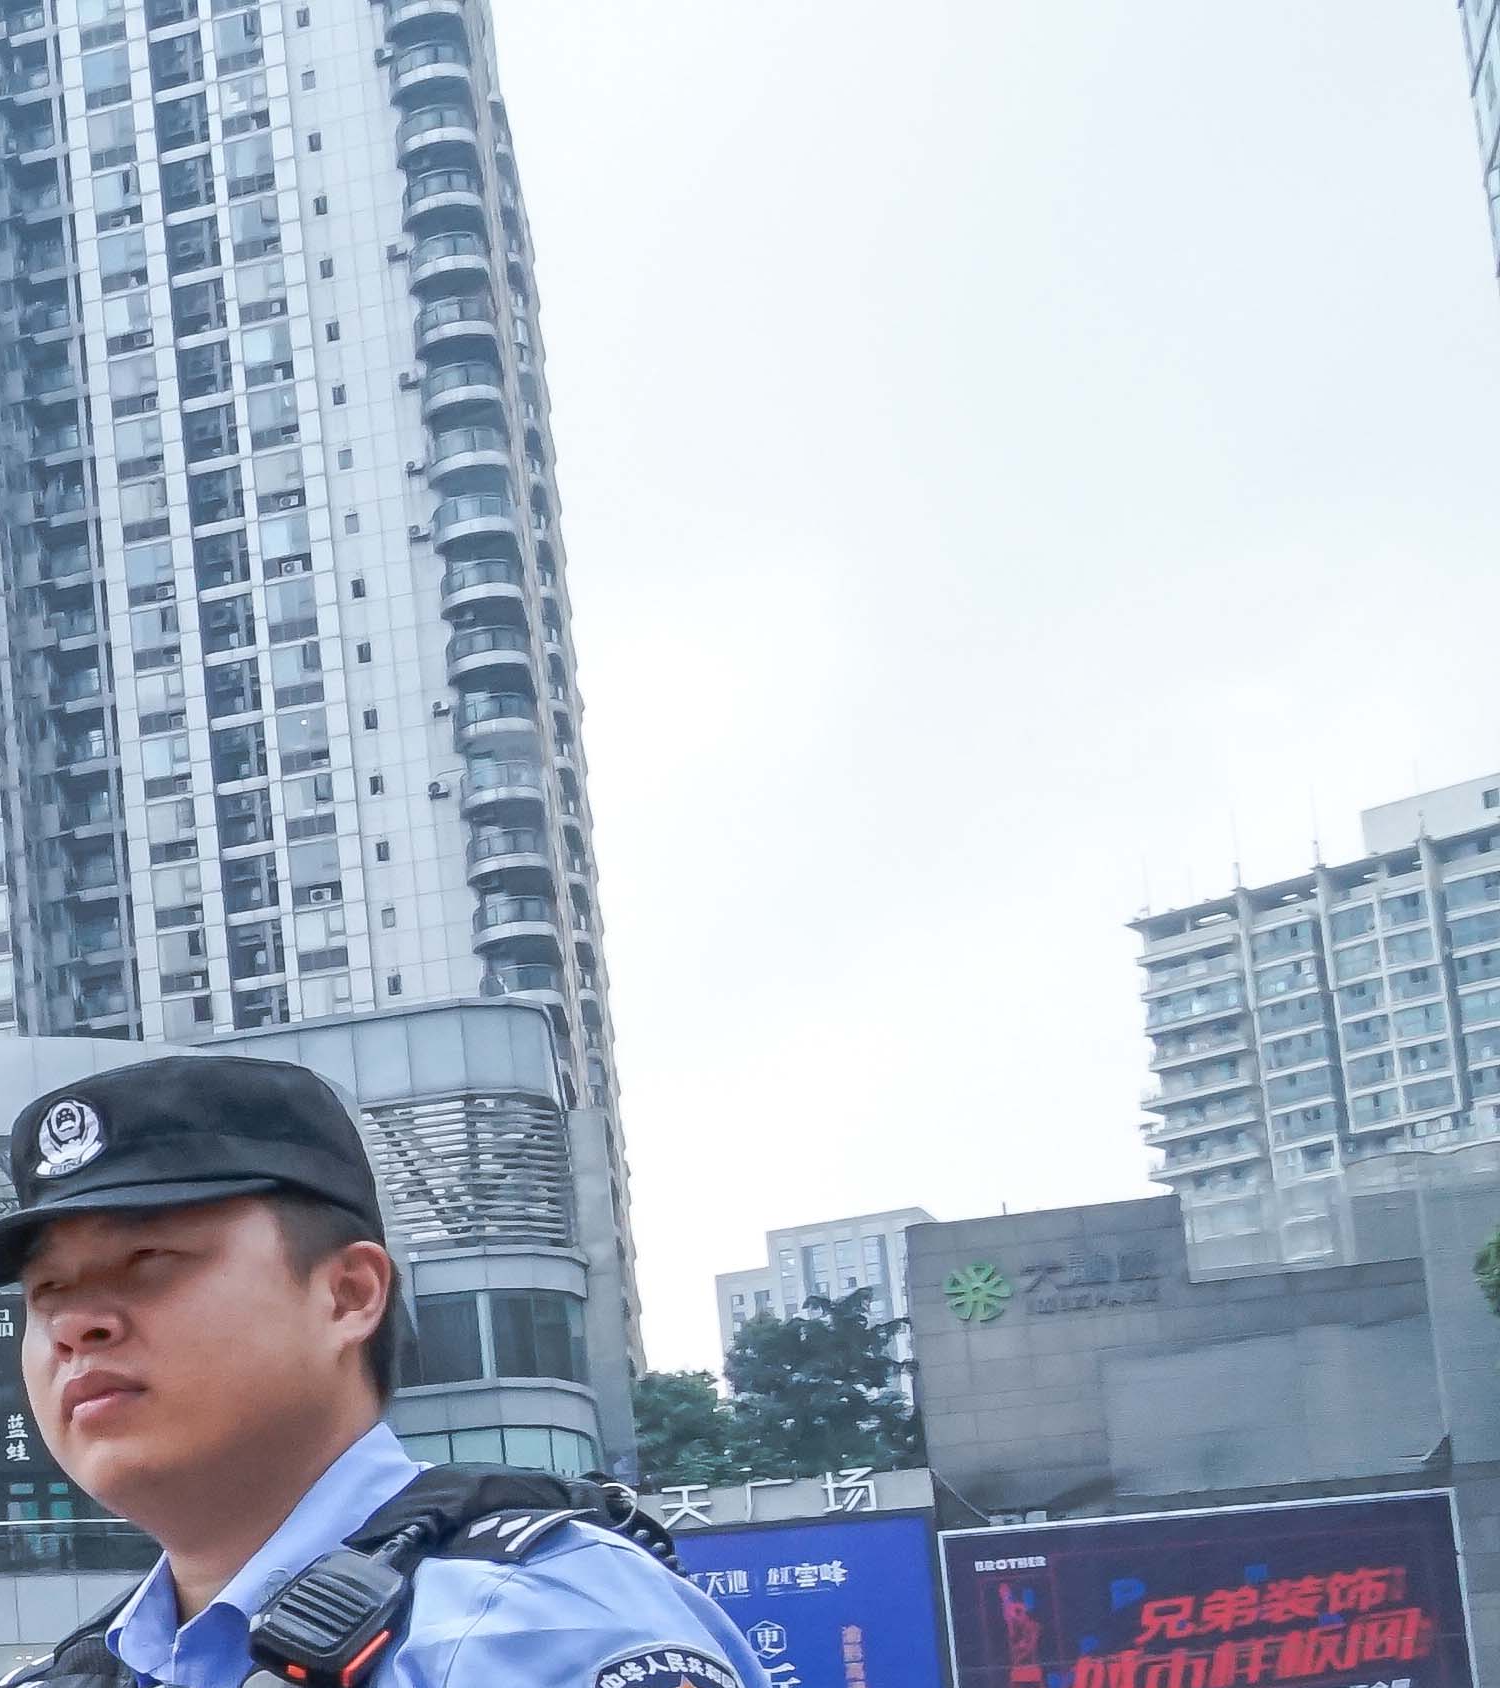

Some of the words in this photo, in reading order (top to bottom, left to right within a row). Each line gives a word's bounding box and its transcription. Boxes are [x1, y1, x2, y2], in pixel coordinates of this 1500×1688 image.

[4, 1413, 31, 1462] 蓝蛙
[1136, 1565, 1405, 1646] 兄弟装饰
